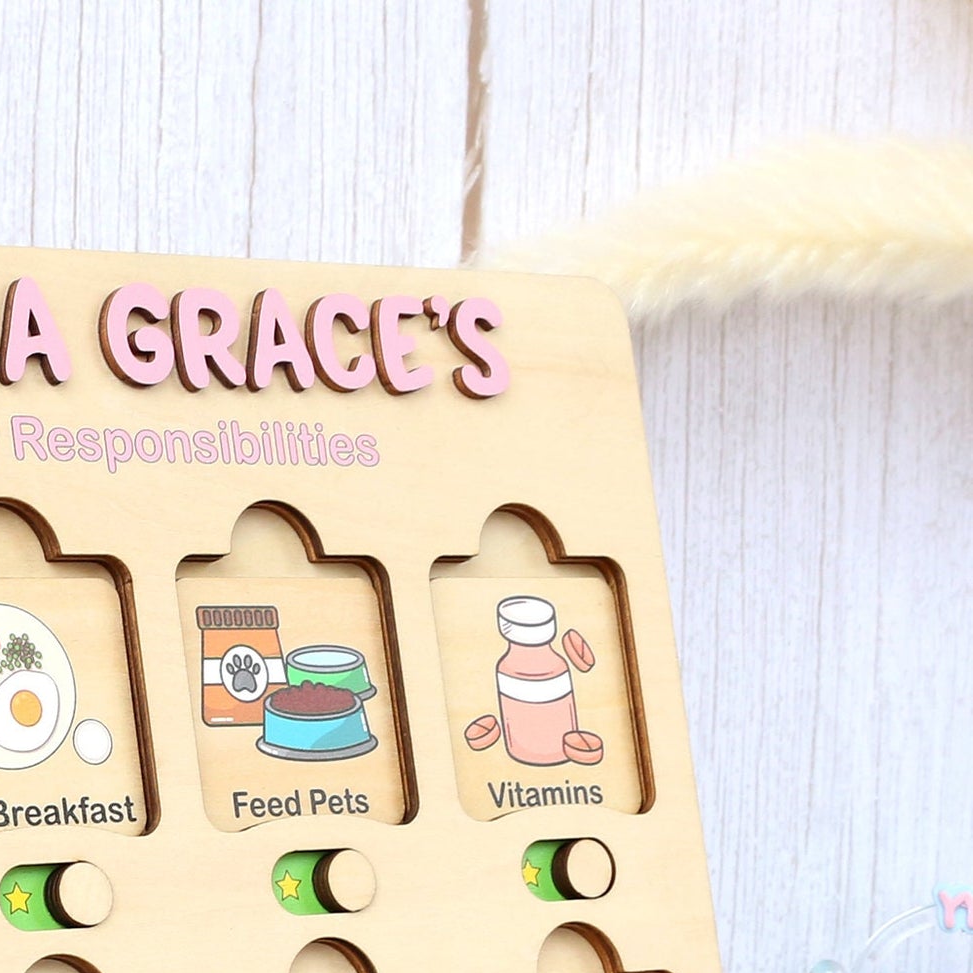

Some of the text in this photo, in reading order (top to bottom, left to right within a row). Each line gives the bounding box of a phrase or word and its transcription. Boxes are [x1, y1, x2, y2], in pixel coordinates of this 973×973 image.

[99, 281, 512, 400] GRACE'S
[11, 415, 381, 474] Responsibilities
[232, 788, 370, 819] Feed Pets
[487, 779, 603, 808] Vitamins
